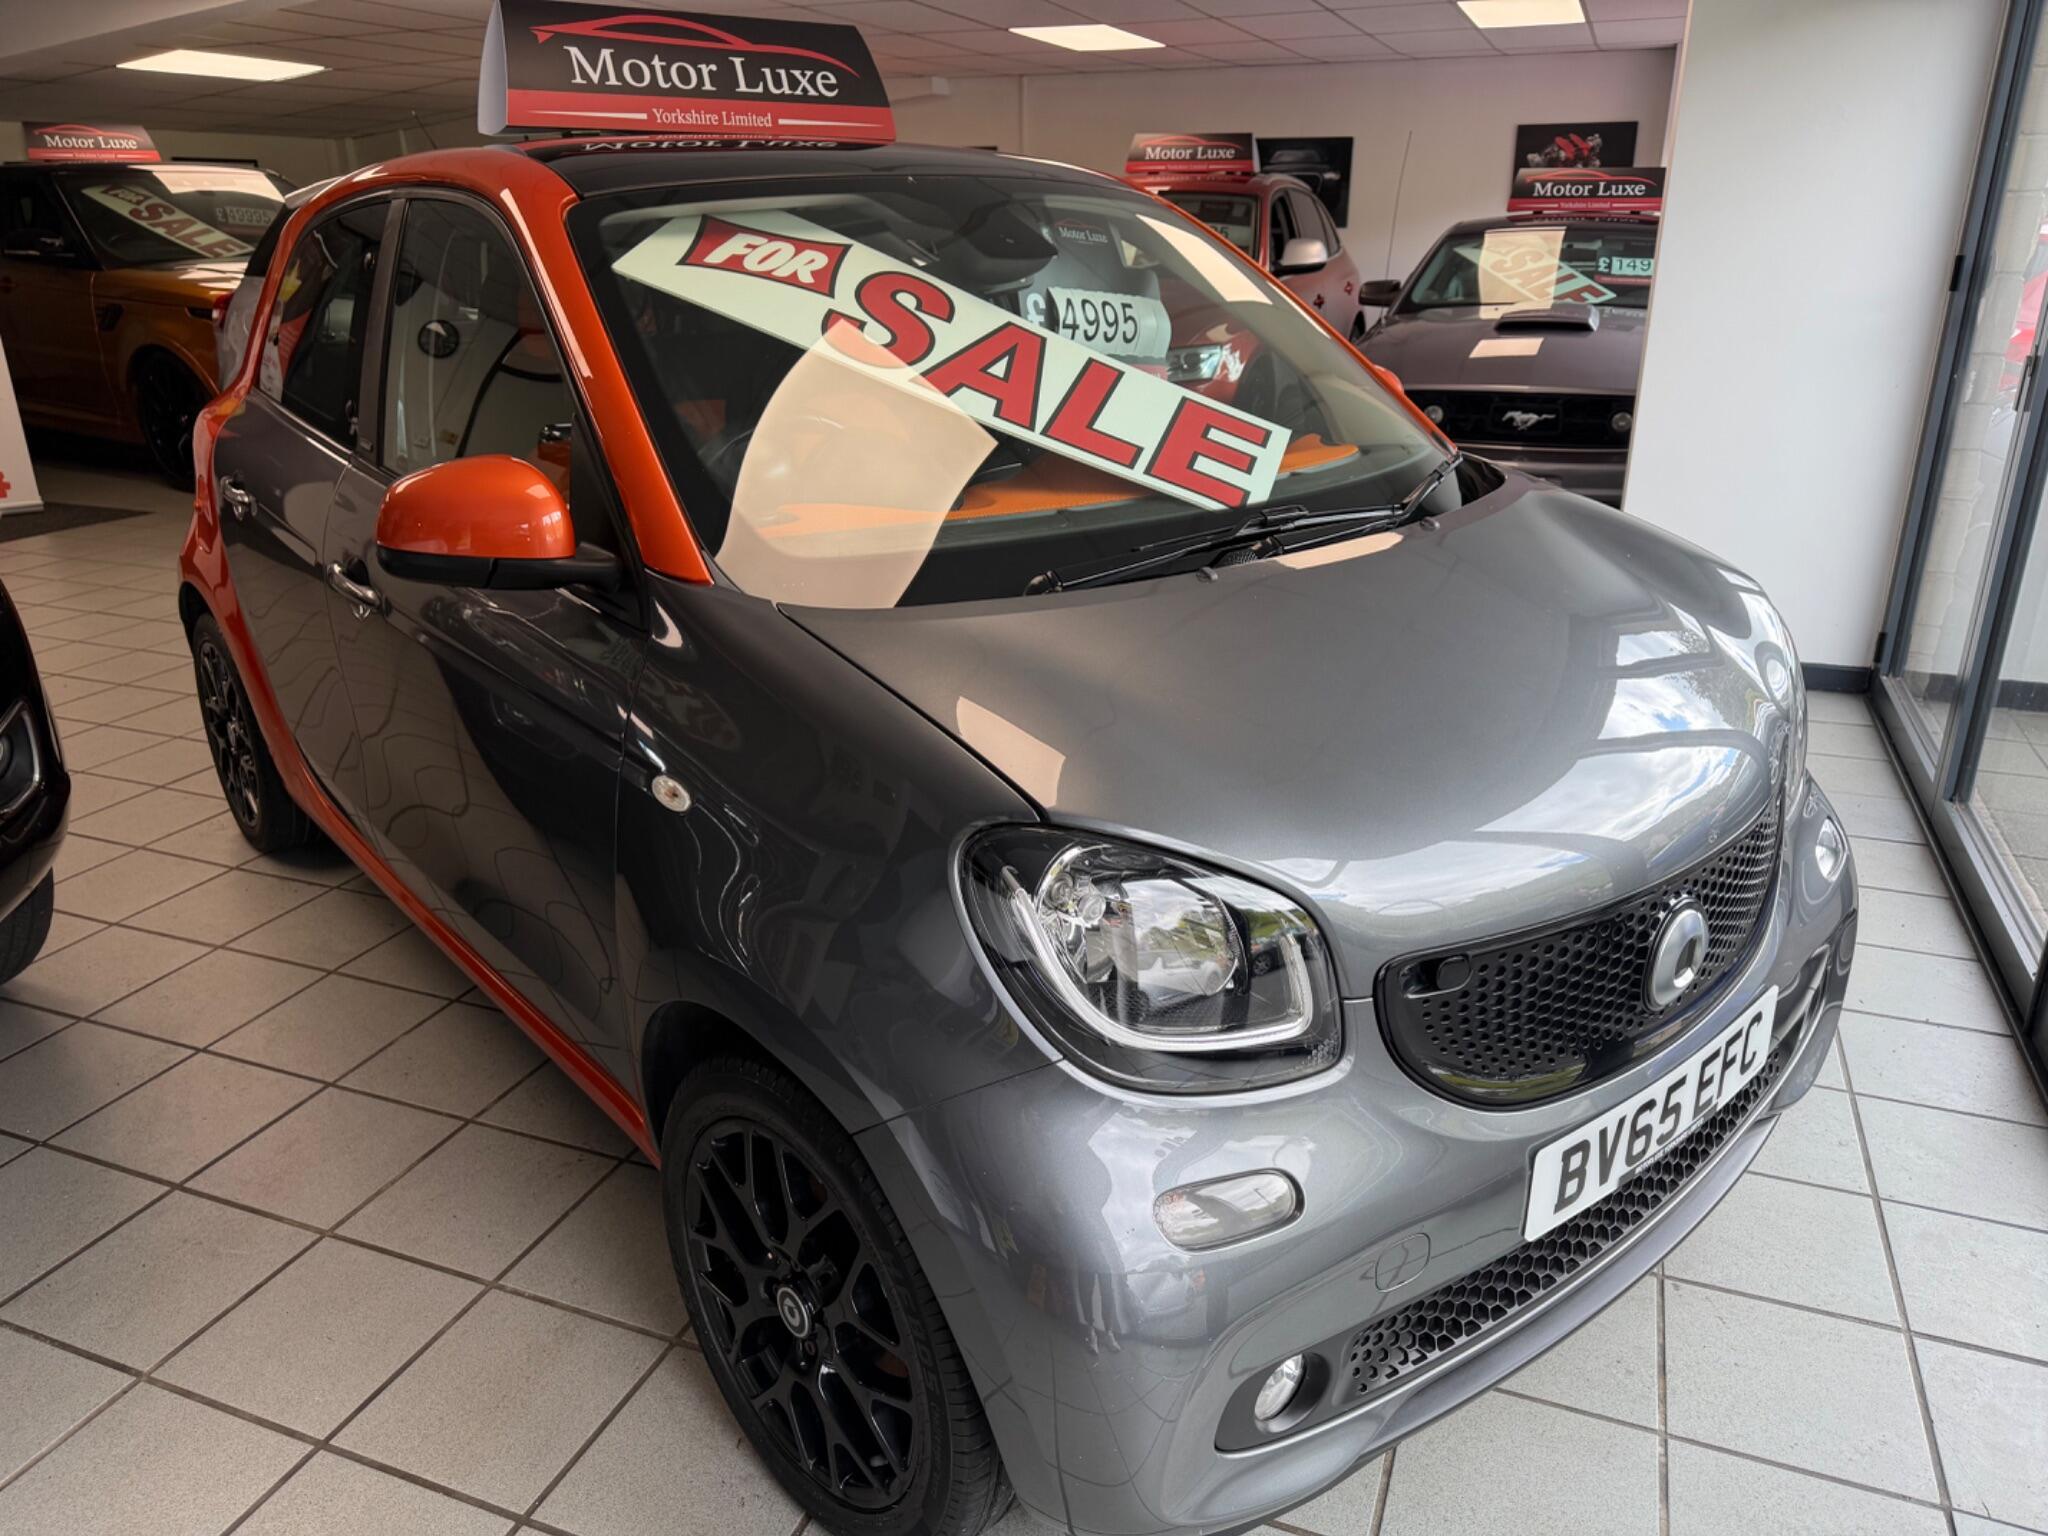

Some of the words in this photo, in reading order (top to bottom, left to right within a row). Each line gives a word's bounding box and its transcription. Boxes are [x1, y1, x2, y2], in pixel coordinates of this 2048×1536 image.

[563, 45, 718, 92] Motor
[728, 56, 839, 98] Luxe
[652, 107, 719, 127] Yorkshire
[723, 111, 773, 128] Limited
[43, 134, 95, 149] Motor
[99, 136, 138, 150] Luxe
[1145, 146, 1192, 161] Motor
[1197, 146, 1236, 160] Luxe
[1532, 182, 1593, 197] Motor
[1597, 181, 1646, 197] Luxe
[129, 202, 244, 257] SALE
[703, 232, 833, 285] FOR
[821, 270, 1272, 509] SALE
[1553, 1074, 1687, 1215] BV65
[1693, 1010, 1763, 1121] EFC
